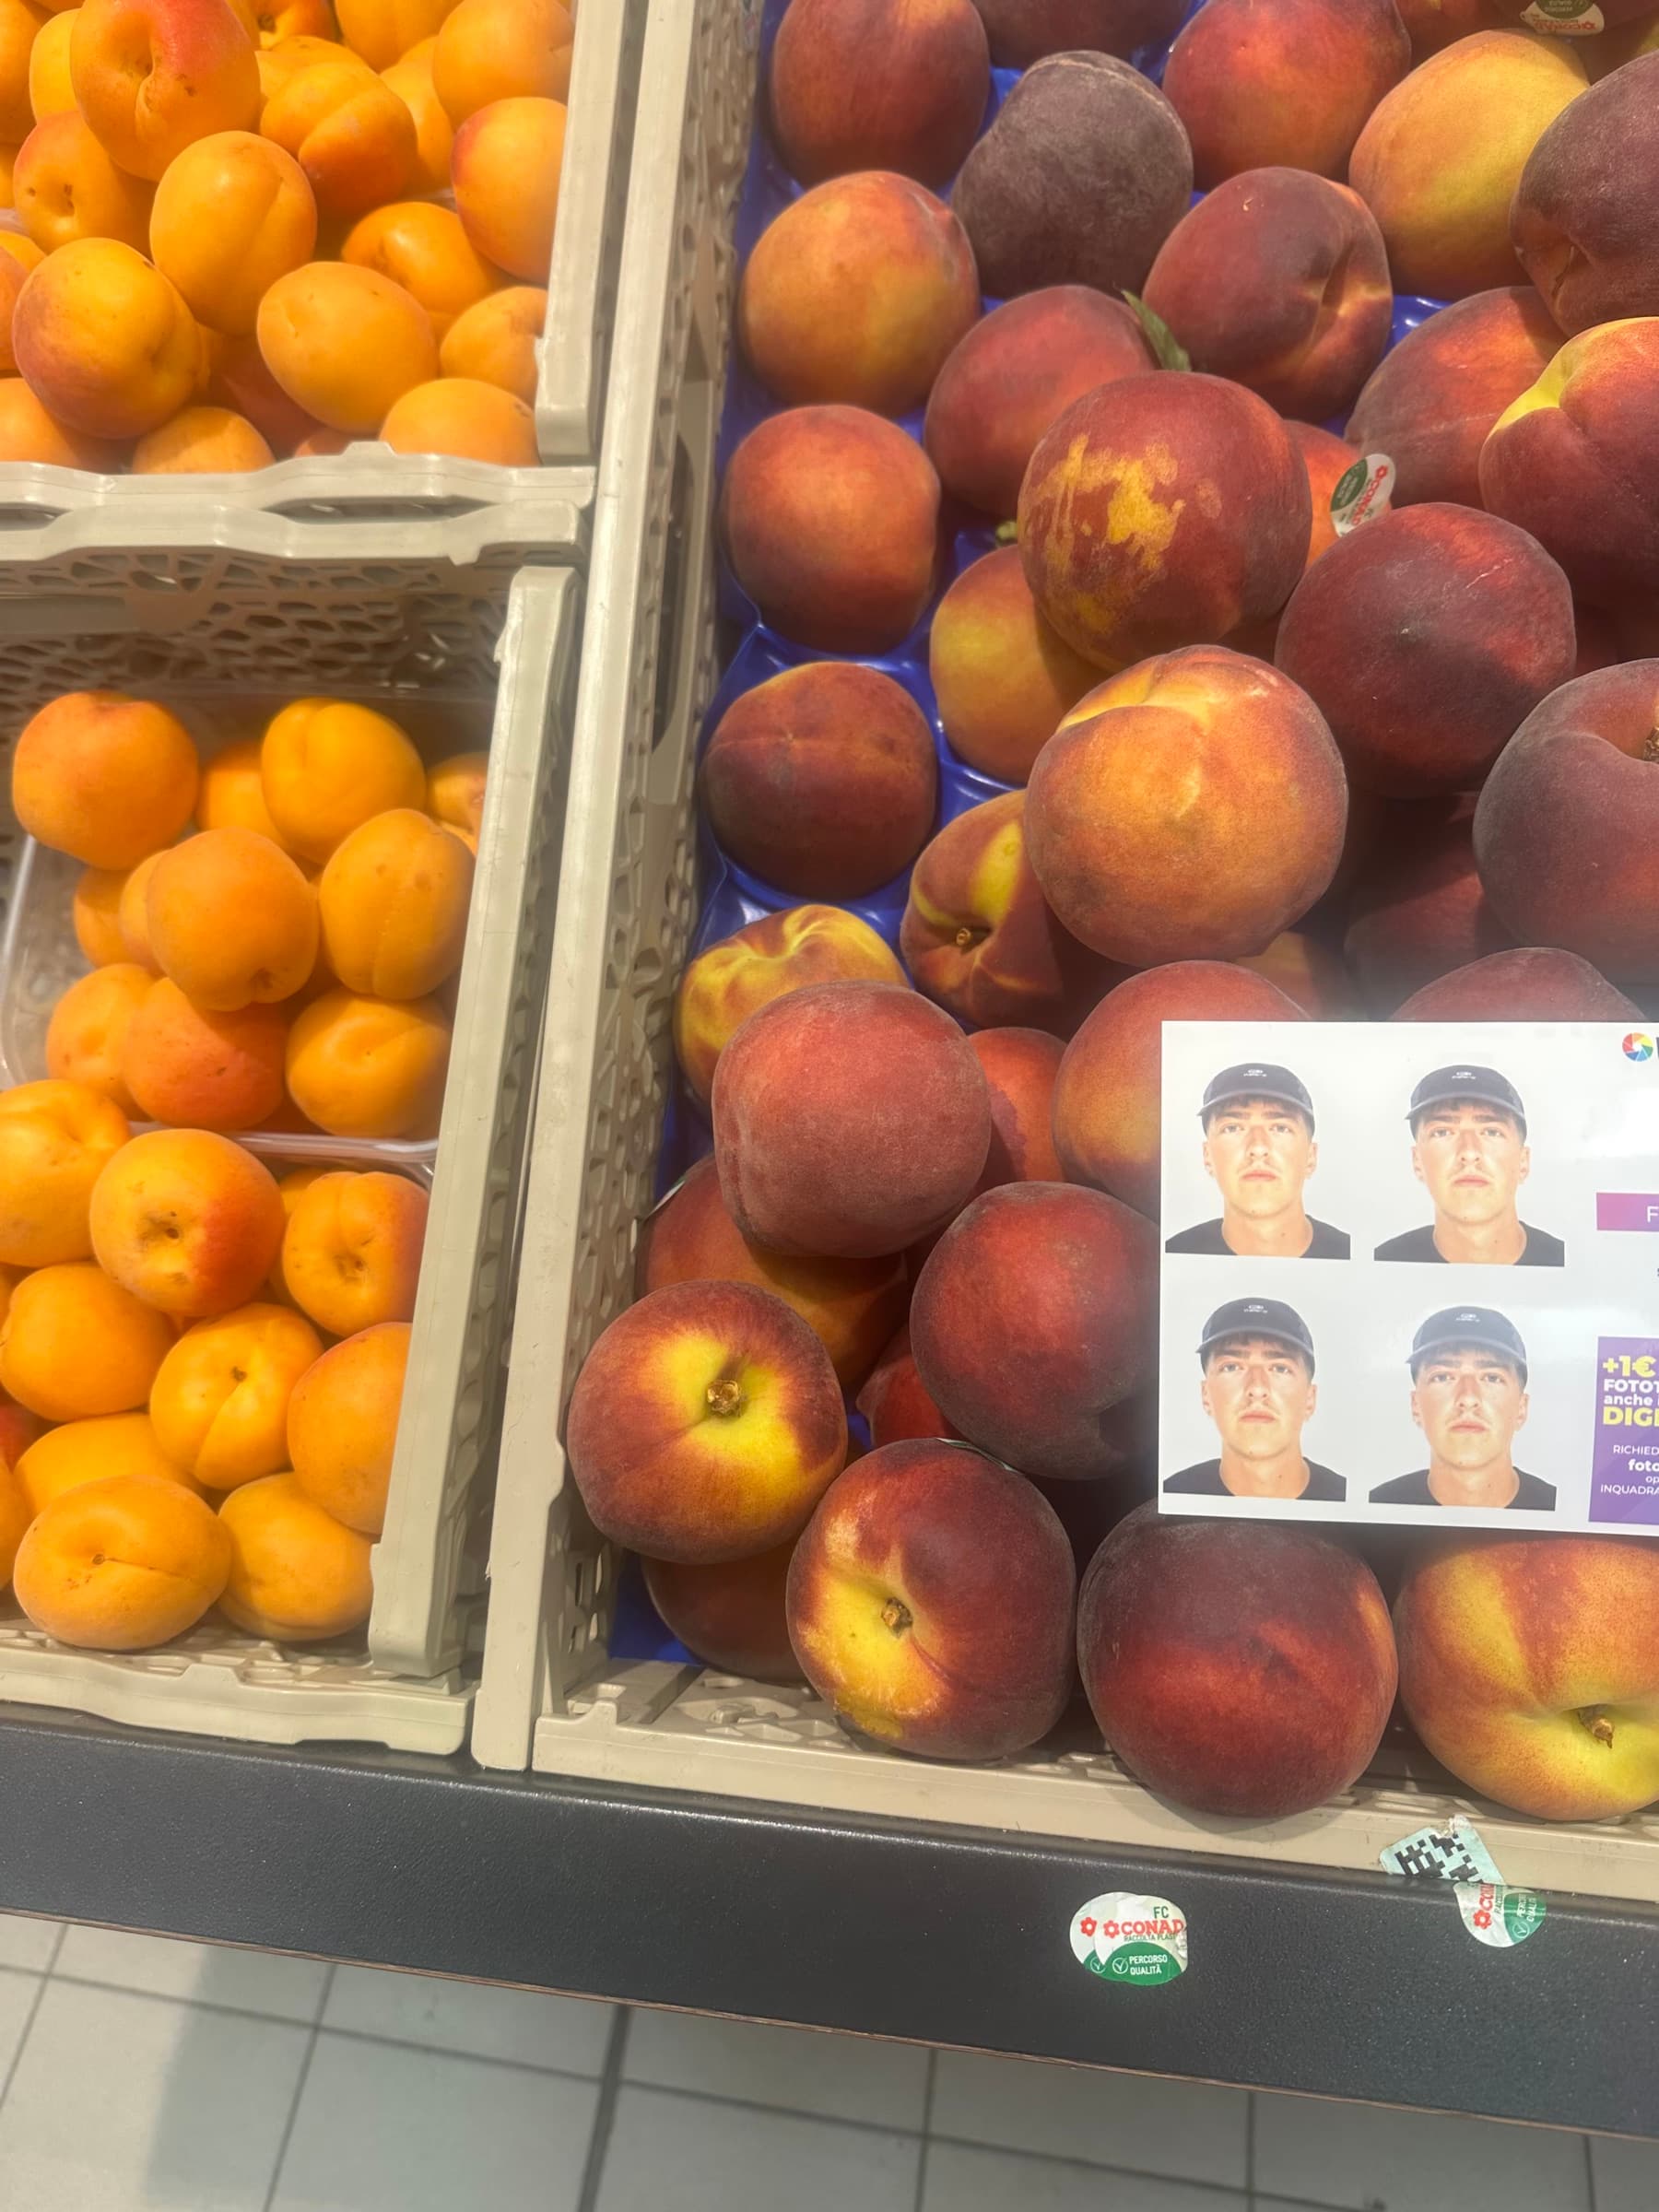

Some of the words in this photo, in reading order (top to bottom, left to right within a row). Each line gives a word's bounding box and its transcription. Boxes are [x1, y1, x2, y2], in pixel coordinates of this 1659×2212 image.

[1602, 1355, 1657, 1378] +1€
[1604, 1393, 1653, 1406] anche
[1628, 1458, 1659, 1472] foto
[1153, 1906, 1170, 1919] FC
[1121, 1919, 1184, 1936] CONAD
[1129, 1954, 1168, 1965] PERCORSO
[1130, 1964, 1162, 1975] QUALITÀ
